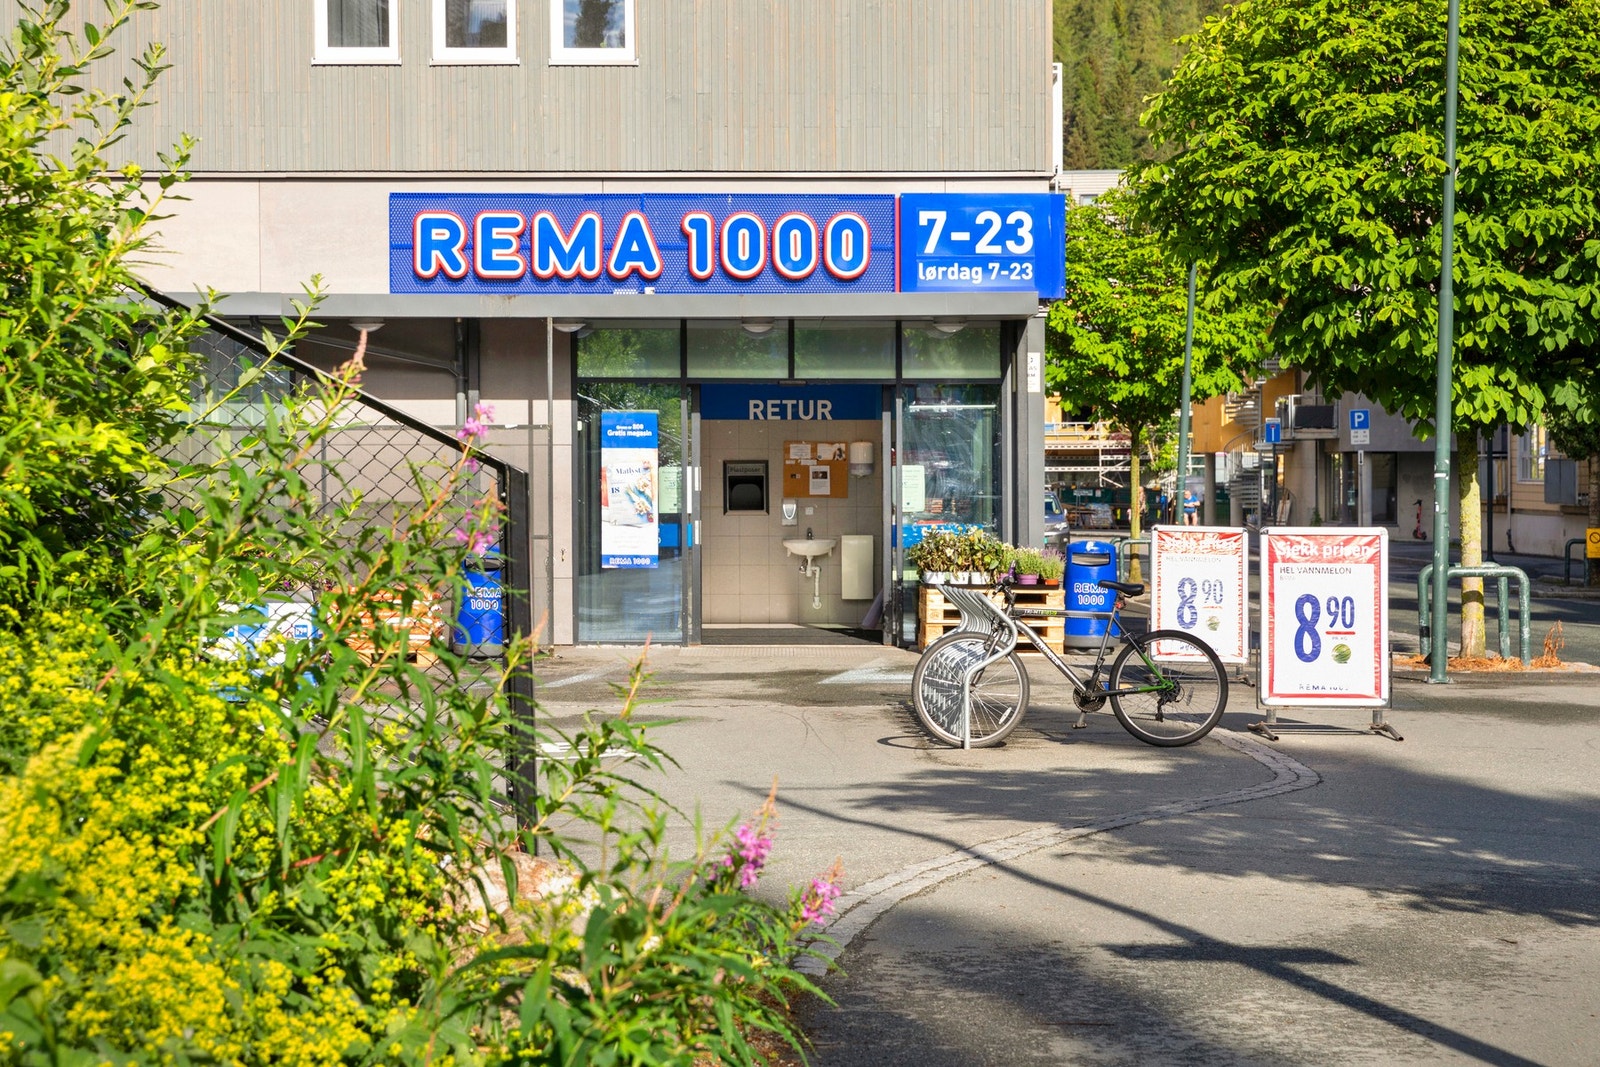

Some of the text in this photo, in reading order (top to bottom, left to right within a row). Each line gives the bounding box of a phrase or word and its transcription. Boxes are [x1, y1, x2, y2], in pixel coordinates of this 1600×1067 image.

[919, 211, 1033, 254] 7-23
[413, 210, 871, 280] REMA 1000
[919, 262, 1033, 284] lørdag 7-23
[749, 400, 832, 420] RETUR
[1355, 412, 1364, 427] P
[1278, 541, 1319, 559] Sjekk
[1280, 566, 1352, 575] HEL VANNMELON
[470, 599, 499, 610] 1000
[1078, 595, 1104, 605] 1000
[1294, 593, 1355, 663] 8 90
